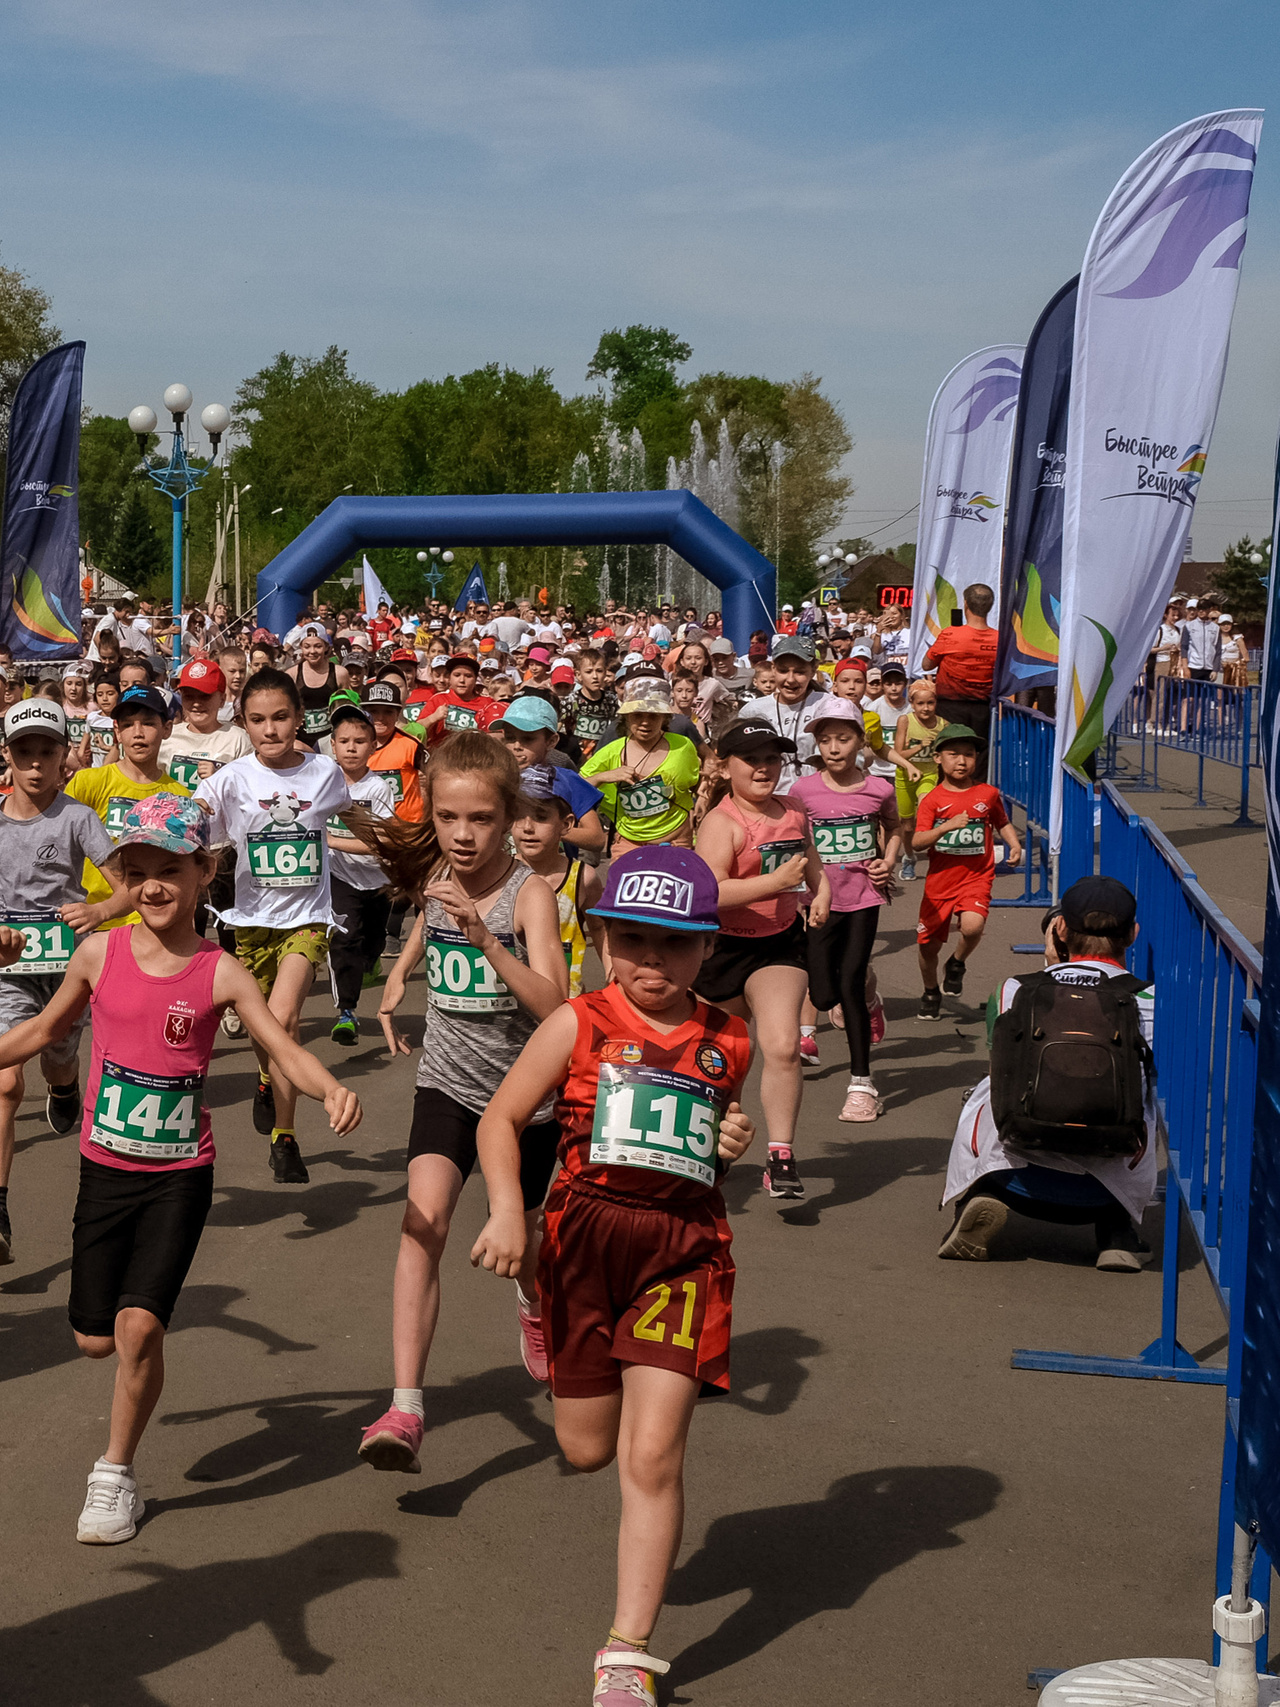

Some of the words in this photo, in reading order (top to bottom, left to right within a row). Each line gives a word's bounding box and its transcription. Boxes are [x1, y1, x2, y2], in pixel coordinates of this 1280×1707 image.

[1105, 428, 1178, 469] Быстрее
[1137, 465, 1186, 503] Ветра
[368, 686, 393, 702] NETS
[11, 708, 59, 725] adidas
[619, 785, 664, 810] 203
[815, 824, 873, 852] 255
[253, 843, 319, 875] 164
[621, 875, 689, 908] OBEY
[427, 945, 508, 993] 301
[98, 1084, 196, 1138] 144
[601, 1088, 714, 1158] 115
[633, 1281, 696, 1350] 21
